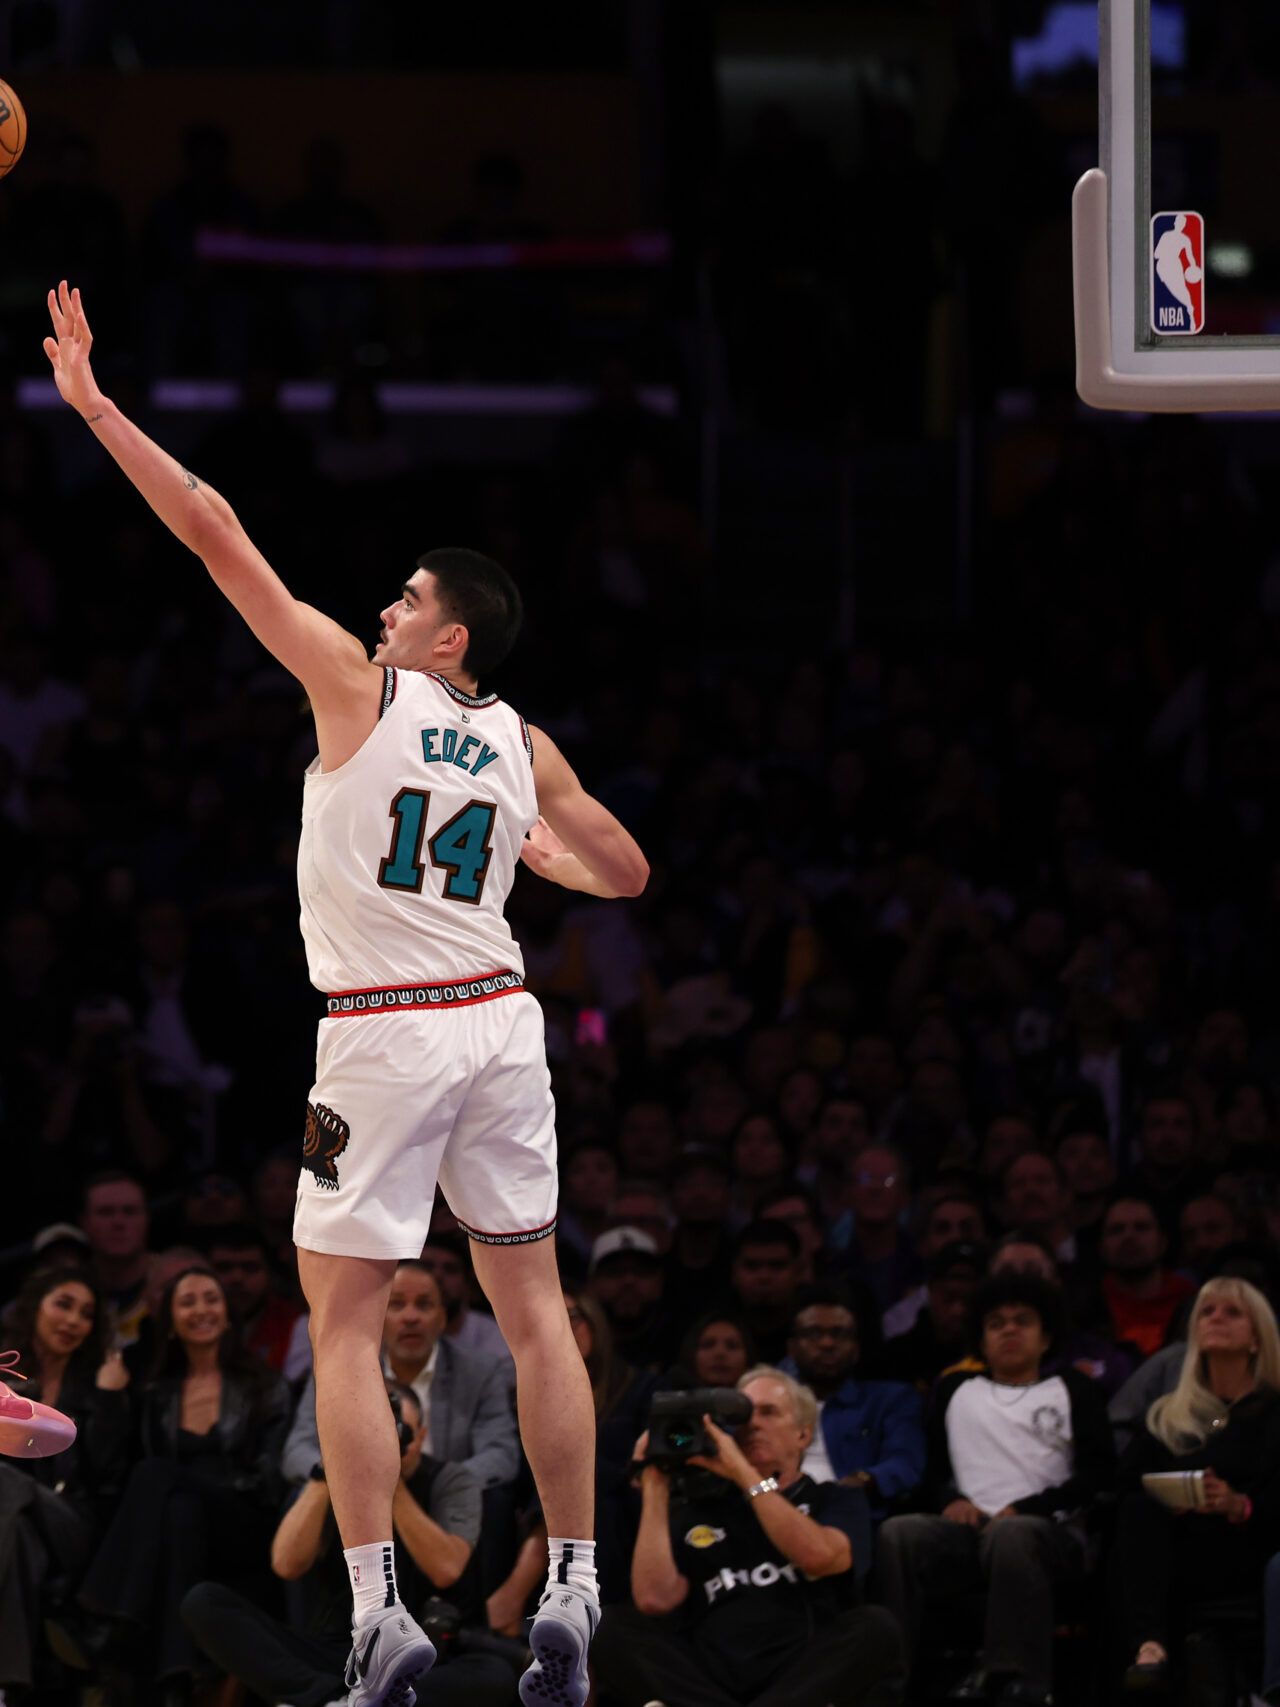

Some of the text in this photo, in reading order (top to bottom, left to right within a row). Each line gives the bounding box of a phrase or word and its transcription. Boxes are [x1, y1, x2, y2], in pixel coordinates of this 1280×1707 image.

[1159, 307, 1185, 327] NBA
[421, 728, 499, 776] EDEY
[377, 786, 497, 906] 14
[704, 1560, 820, 1605] PHOT
